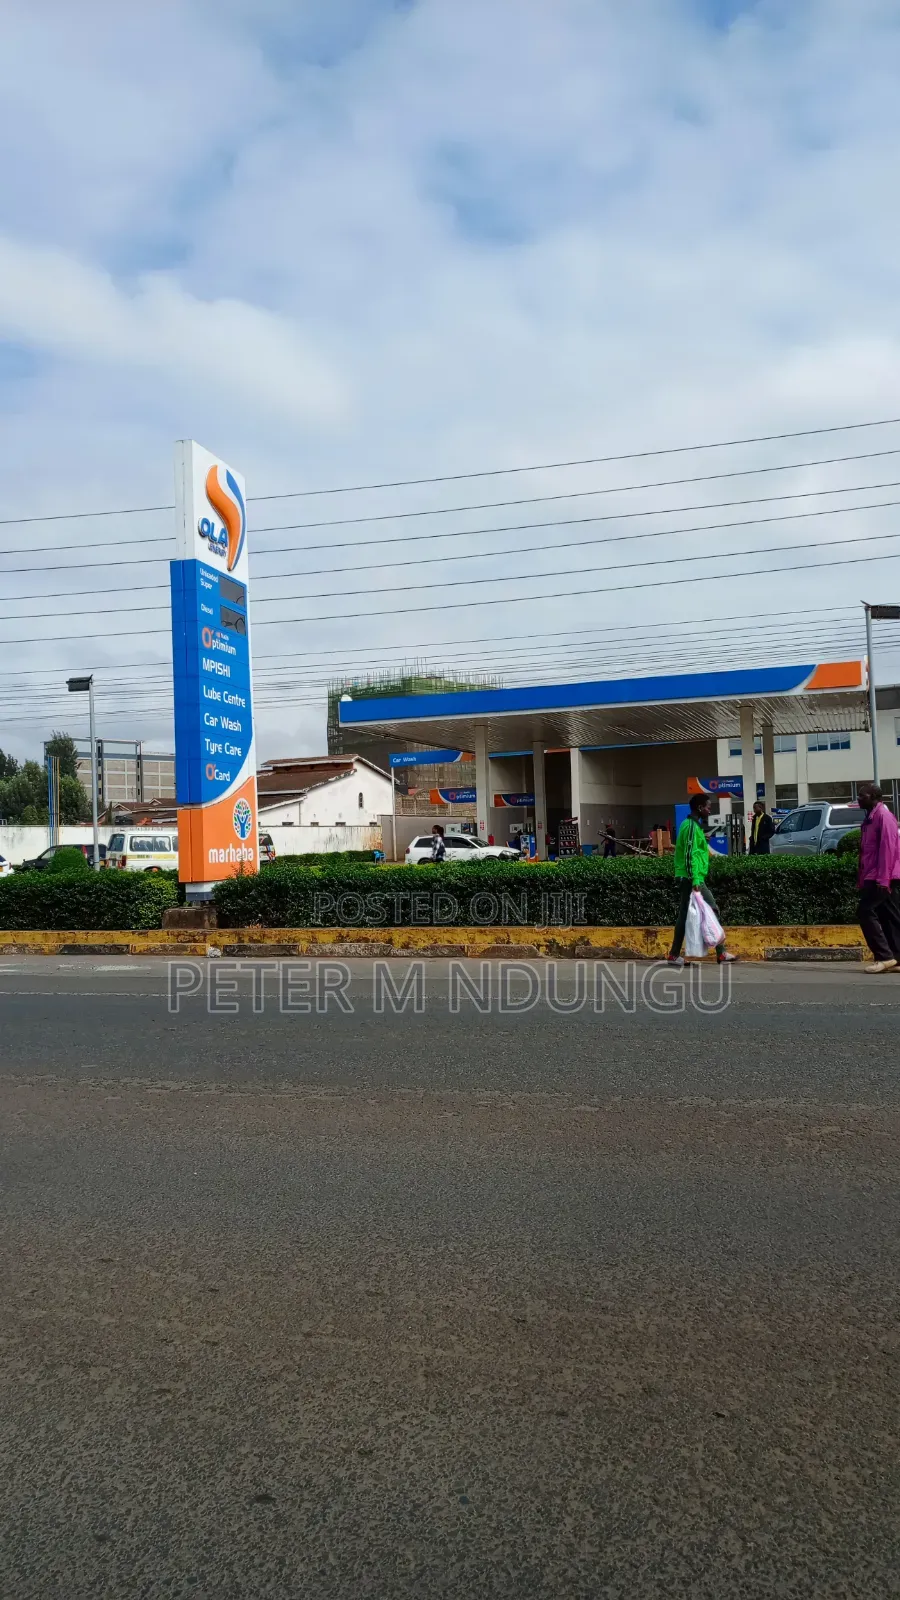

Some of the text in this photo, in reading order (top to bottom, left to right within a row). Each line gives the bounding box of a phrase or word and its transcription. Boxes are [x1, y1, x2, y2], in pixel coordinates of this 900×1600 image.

[199, 517, 229, 548] OLA
[203, 658, 231, 678] MPISHI
[203, 685, 246, 708] Lube Centre
[204, 712, 242, 732] Car Wash
[204, 738, 242, 757] Tyre Care
[208, 843, 254, 864] marhaba
